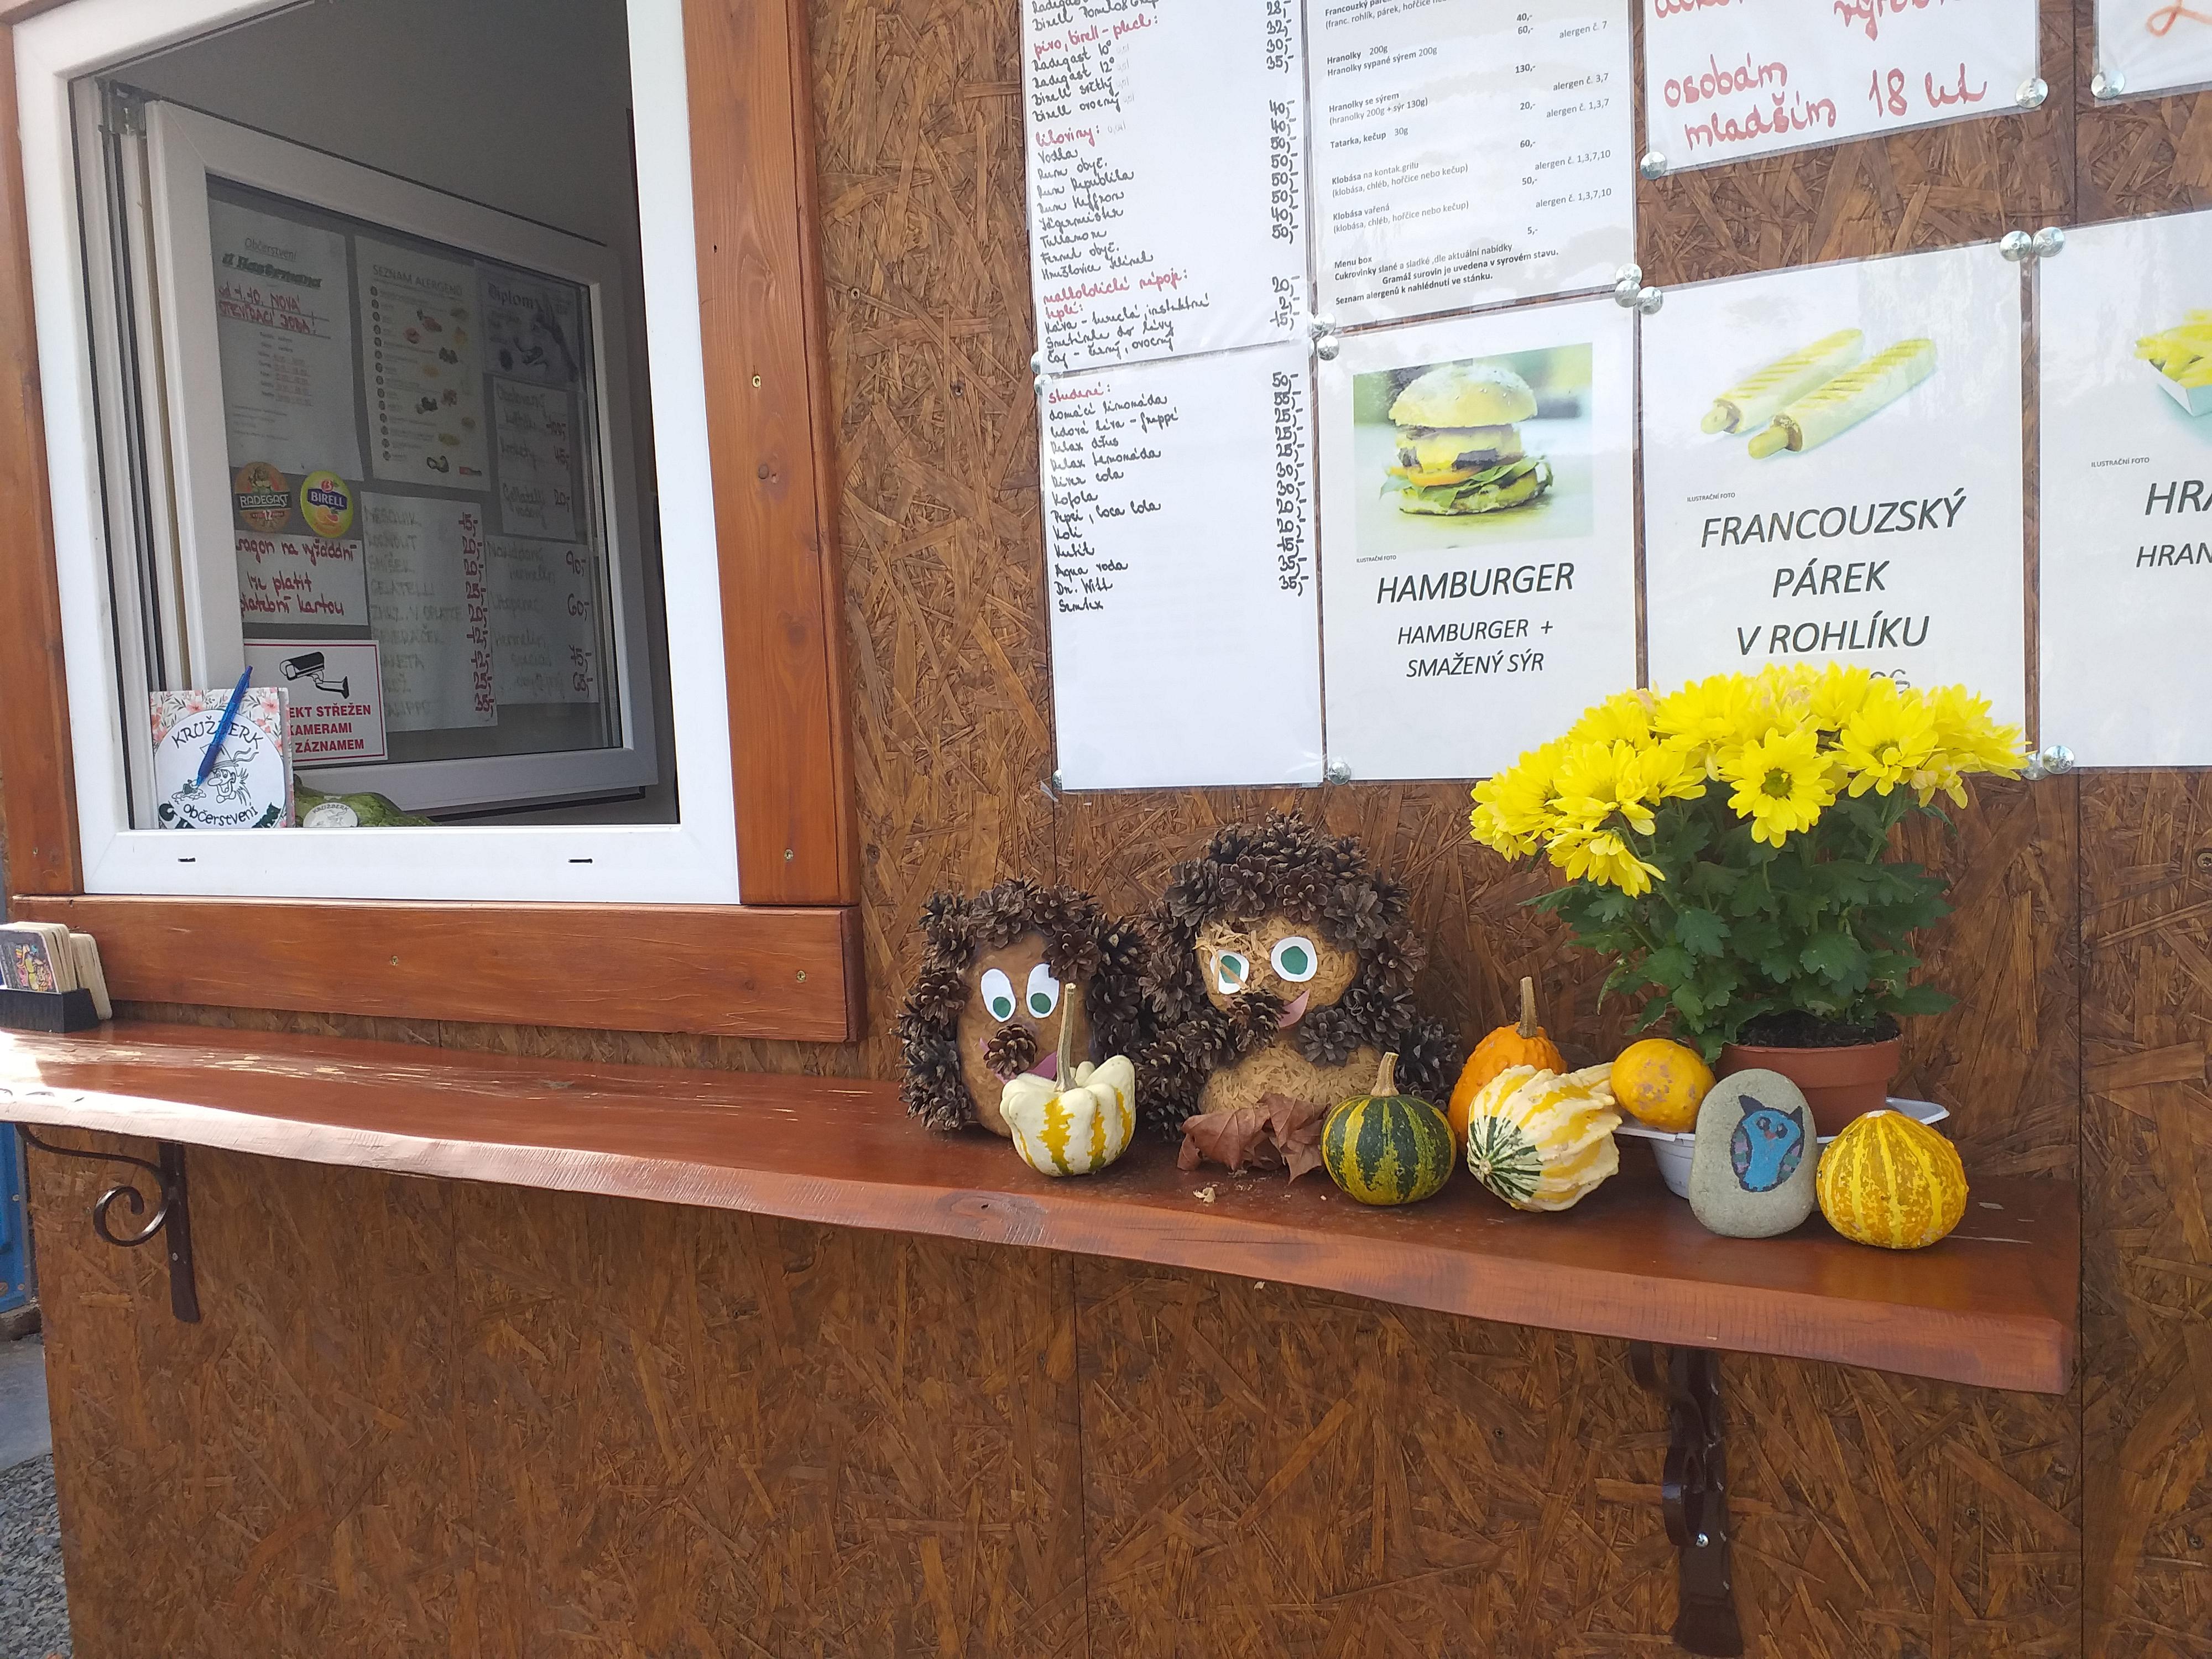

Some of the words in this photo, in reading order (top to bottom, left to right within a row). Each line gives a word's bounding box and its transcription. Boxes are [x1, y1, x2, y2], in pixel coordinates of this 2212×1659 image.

[1325, 0, 1368, 17] Francouzký
[1352, 11, 1375, 23] rohlík,
[1377, 5, 1401, 18] párek,
[1559, 24, 1590, 38] alergen
[1602, 20, 1607, 29] 7
[1327, 51, 1361, 65] Hranolky
[1369, 45, 1388, 56] 200g
[1327, 64, 1361, 76] Hranolky
[1364, 56, 1391, 70] sypané
[1393, 51, 1416, 63] sýrem
[1418, 46, 1437, 58] 200g
[1553, 78, 1584, 91] alergen
[1596, 73, 1609, 83] 3,7
[1663, 53, 1788, 108] osobám
[1329, 100, 1363, 113] Hranolky
[1375, 93, 1399, 104] sýrem
[1329, 112, 1364, 126] (hranolky
[1366, 107, 1385, 118] 200g
[1394, 103, 1405, 112] sýr
[1407, 97, 1428, 109] 130g)
[1546, 107, 1577, 118] alergen
[1589, 98, 1609, 110] 1,3,7
[1684, 90, 1837, 152] mladším
[1868, 67, 1908, 118] 18
[1330, 137, 1361, 149] Tatarka,
[1363, 132, 1386, 143] kečup
[1394, 127, 1408, 136] 30g
[1535, 159, 1566, 170] alergen
[1577, 150, 1611, 164] 1,3,7,10
[1332, 173, 1361, 185] Klobása
[1332, 185, 1365, 198] (klobása,
[1367, 180, 1389, 191] chléb,
[1391, 174, 1418, 185] hořčice
[1421, 170, 1441, 180] nebo
[1442, 164, 1468, 176] kečup)
[1536, 197, 1566, 207] alergen
[1578, 188, 1611, 201] 1,3,7,10
[1333, 209, 1362, 221] Klobása
[1364, 203, 1390, 215] vařená
[1333, 221, 1366, 234] (klobása,
[1368, 216, 1390, 227] chléb,
[1392, 211, 1420, 222] hořčice
[1422, 206, 1441, 217] nebo
[1443, 201, 1469, 213] kečup)
[1334, 259, 1357, 269] Menu
[1358, 257, 1372, 265] box
[1335, 267, 1376, 281] Cukrovinky
[1379, 262, 1397, 273] slané
[1406, 257, 1430, 269] sladké
[1448, 248, 1479, 261] aktuální
[1481, 243, 1512, 255] nabídky
[1383, 275, 1411, 285] Gramáž
[1413, 268, 1442, 280] surovin
[1444, 266, 1451, 276] je
[1453, 260, 1488, 272] uvedena
[1496, 253, 1531, 267] syrovém
[1533, 249, 1558, 259] stavu.
[1335, 295, 1364, 305] Seznam
[1366, 286, 1399, 299] alergenů
[1401, 285, 1406, 294] k
[1407, 278, 1450, 293] nahlédnutí
[1463, 272, 1493, 284] stánku.
[2091, 458, 2130, 468] ILUSTRAČNÍ
[2131, 457, 2150, 465] FOTO
[239, 494, 288, 508] RADEGAST
[311, 491, 344, 507] BIRELL
[1052, 492, 1099, 508] Kofola
[1687, 493, 1720, 503] ILUSTRAČNÍ
[1720, 492, 1736, 500] FOTO
[1701, 487, 1966, 548] FRANCOUZSKÝ
[281, 541, 299, 556] na
[272, 570, 312, 597] platit
[1376, 562, 1575, 604] HAMBURGER
[1772, 558, 1890, 598] PÁREK
[296, 593, 345, 616] kartou
[1058, 598, 1104, 613] Semtex
[1397, 619, 1529, 645] HAMBURGER
[1540, 620, 1554, 635] +
[1736, 625, 1762, 655] V
[1769, 611, 1930, 654] ROHLÍKU
[1406, 650, 1504, 677] SMAŽENÝ
[1506, 648, 1544, 673] SÝR
[289, 706, 312, 718] EKT
[316, 702, 372, 717] STŘEŽEN
[171, 716, 263, 750] KRUŽERK
[295, 738, 364, 753] ZÁZNAMEM
